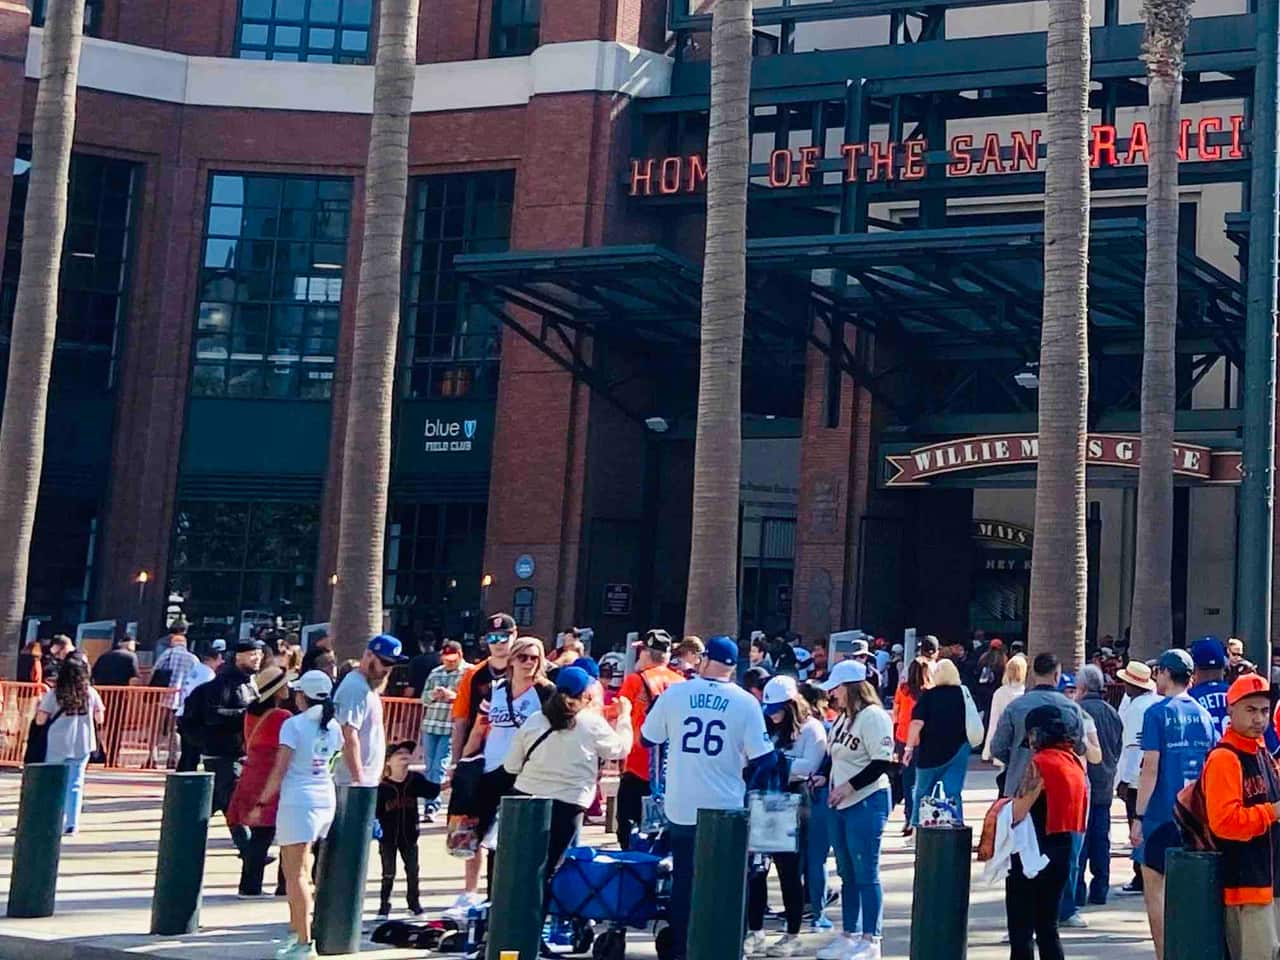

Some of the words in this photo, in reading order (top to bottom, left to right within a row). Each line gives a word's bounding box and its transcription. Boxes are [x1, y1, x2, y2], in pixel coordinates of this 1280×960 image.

[628, 154, 709, 197] HOM
[769, 146, 821, 188] OF
[841, 138, 928, 184] THE
[949, 129, 1041, 176] SAN
[424, 418, 461, 437] blue
[914, 440, 1010, 472] WILLIE
[1021, 439, 1103, 458] MS
[1115, 441, 1200, 470] GE
[979, 523, 1027, 543] MAYS
[689, 694, 730, 713] UBEDA
[1198, 692, 1228, 710] BETT
[682, 716, 727, 757] 26
